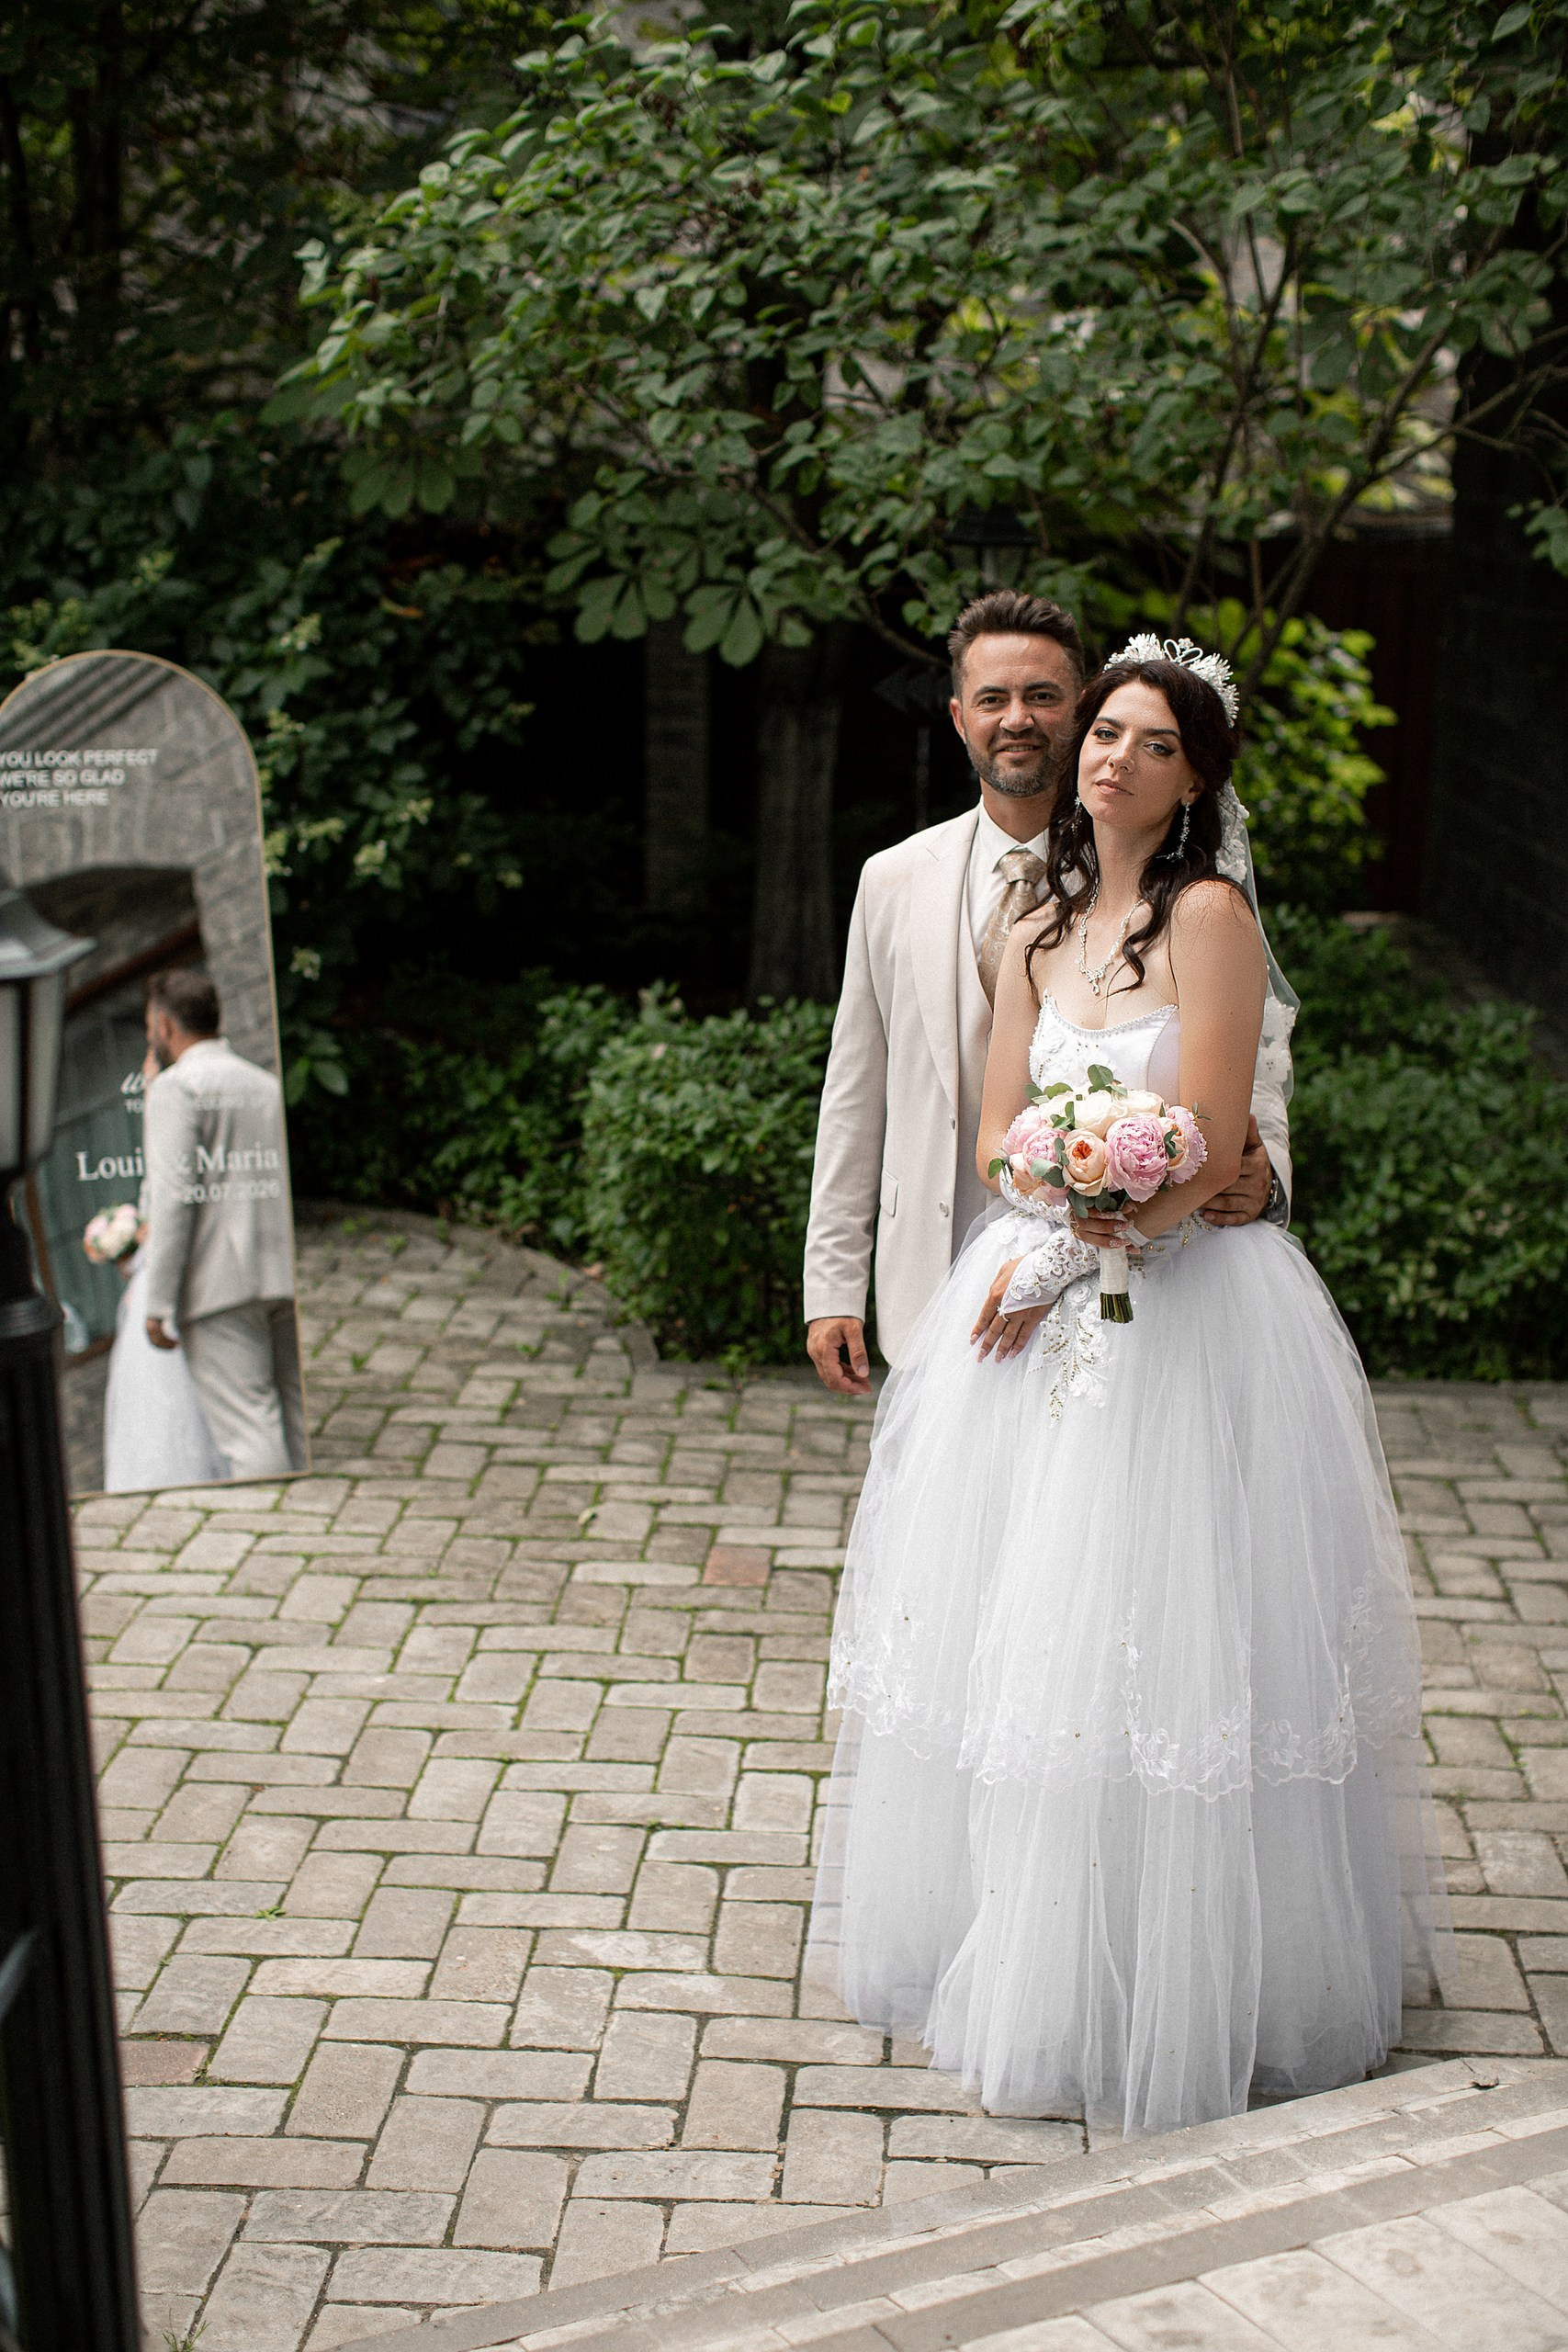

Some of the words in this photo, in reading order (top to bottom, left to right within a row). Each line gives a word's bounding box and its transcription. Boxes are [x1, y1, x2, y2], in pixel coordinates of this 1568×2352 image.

[35, 750, 81, 768] LOOK
[83, 749, 158, 767] PERFECT
[52, 769, 77, 787] SO
[79, 768, 126, 786] GLAD
[62, 788, 109, 808] HERE
[76, 1146, 146, 1182] Loui
[196, 1141, 278, 1174] Maria
